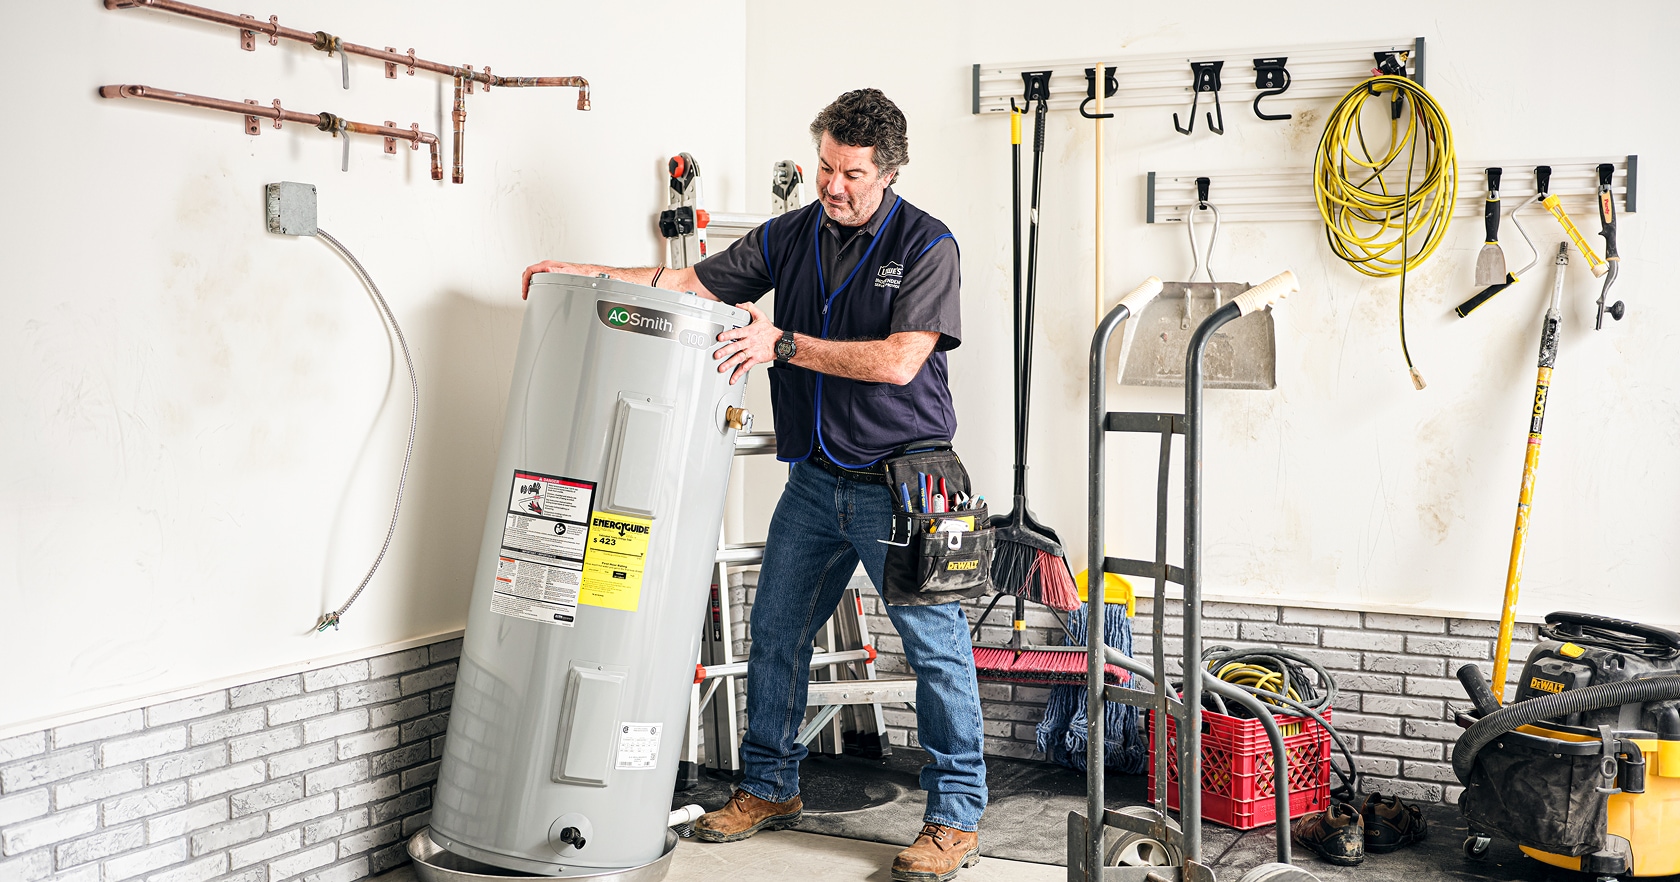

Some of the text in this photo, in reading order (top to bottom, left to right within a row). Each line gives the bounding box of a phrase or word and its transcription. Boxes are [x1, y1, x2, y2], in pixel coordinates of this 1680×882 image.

[687, 332, 705, 346] 100
[1532, 386, 1548, 418] LOCK
[592, 517, 650, 537] ENERGYGUIDE
[599, 537, 617, 546] 423
